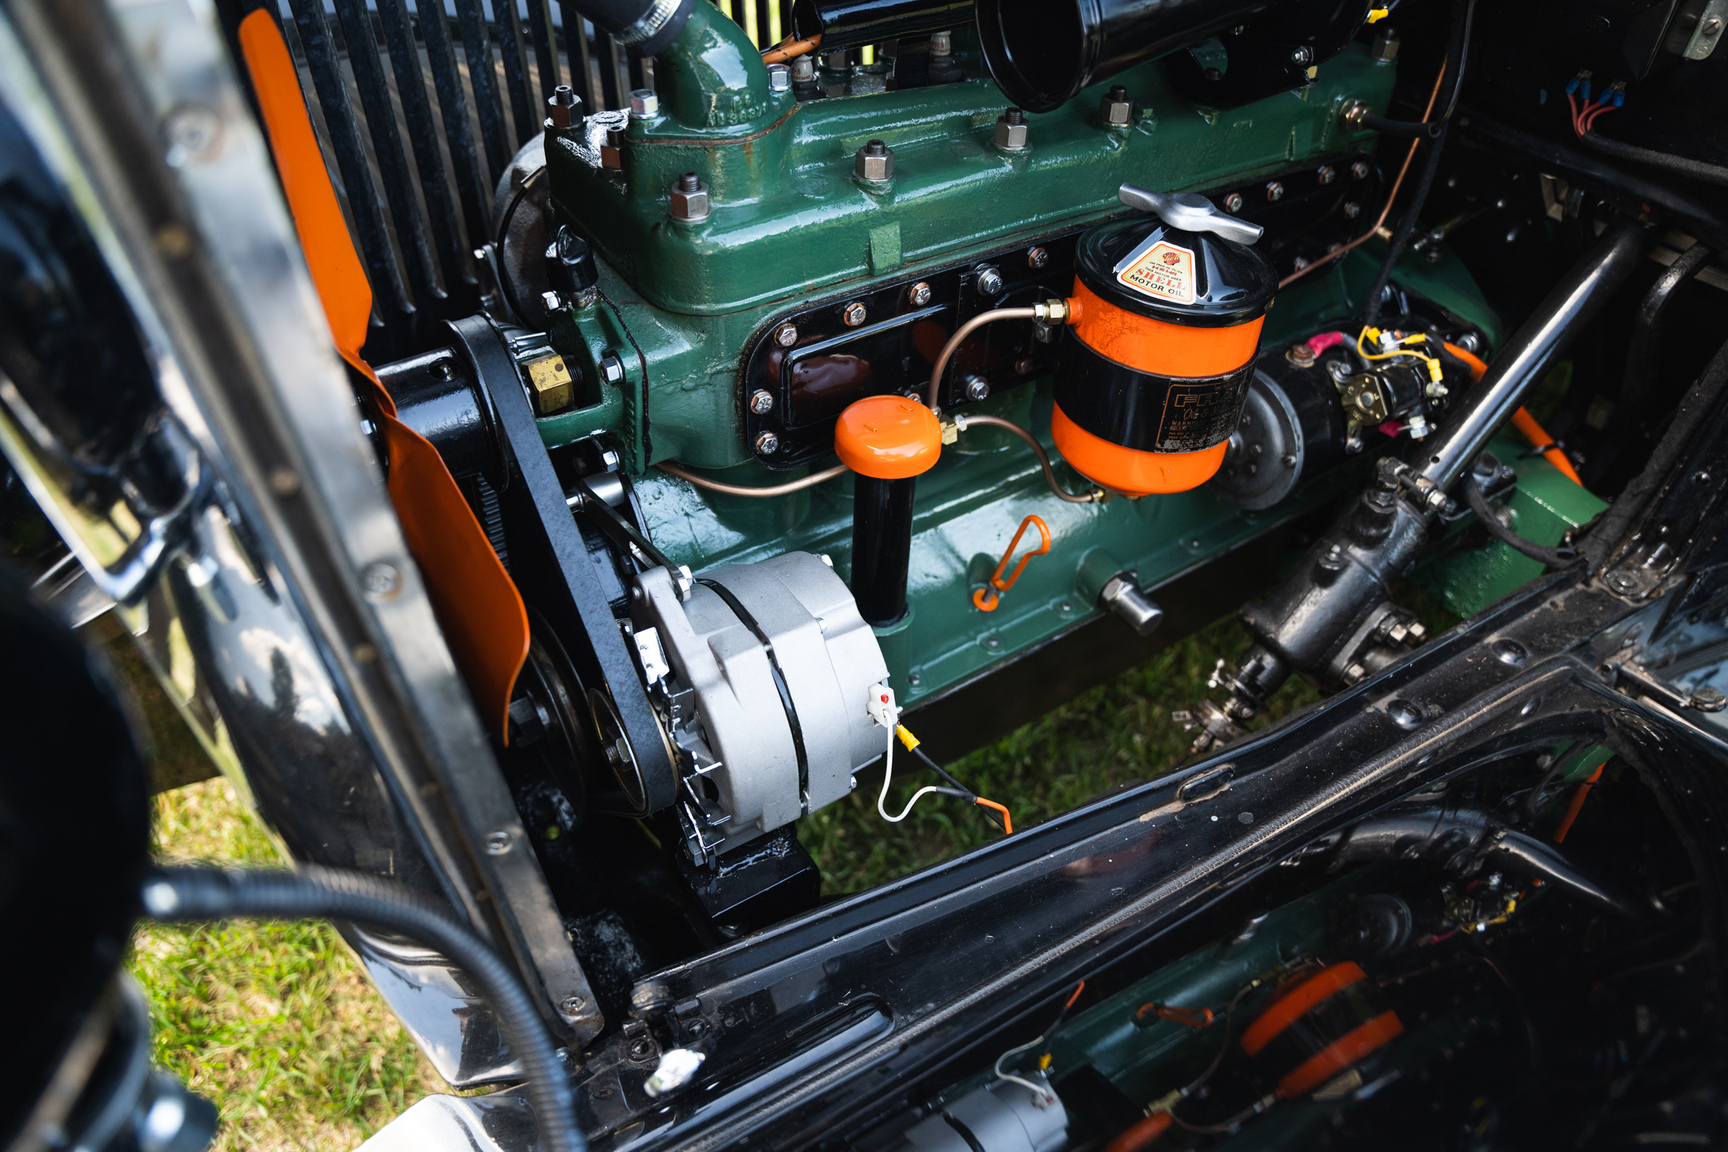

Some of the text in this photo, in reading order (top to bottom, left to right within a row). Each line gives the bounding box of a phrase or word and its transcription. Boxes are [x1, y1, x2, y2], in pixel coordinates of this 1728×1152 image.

[1129, 274, 1184, 297] MOTOR OIL
[1135, 268, 1186, 290] SHELL
